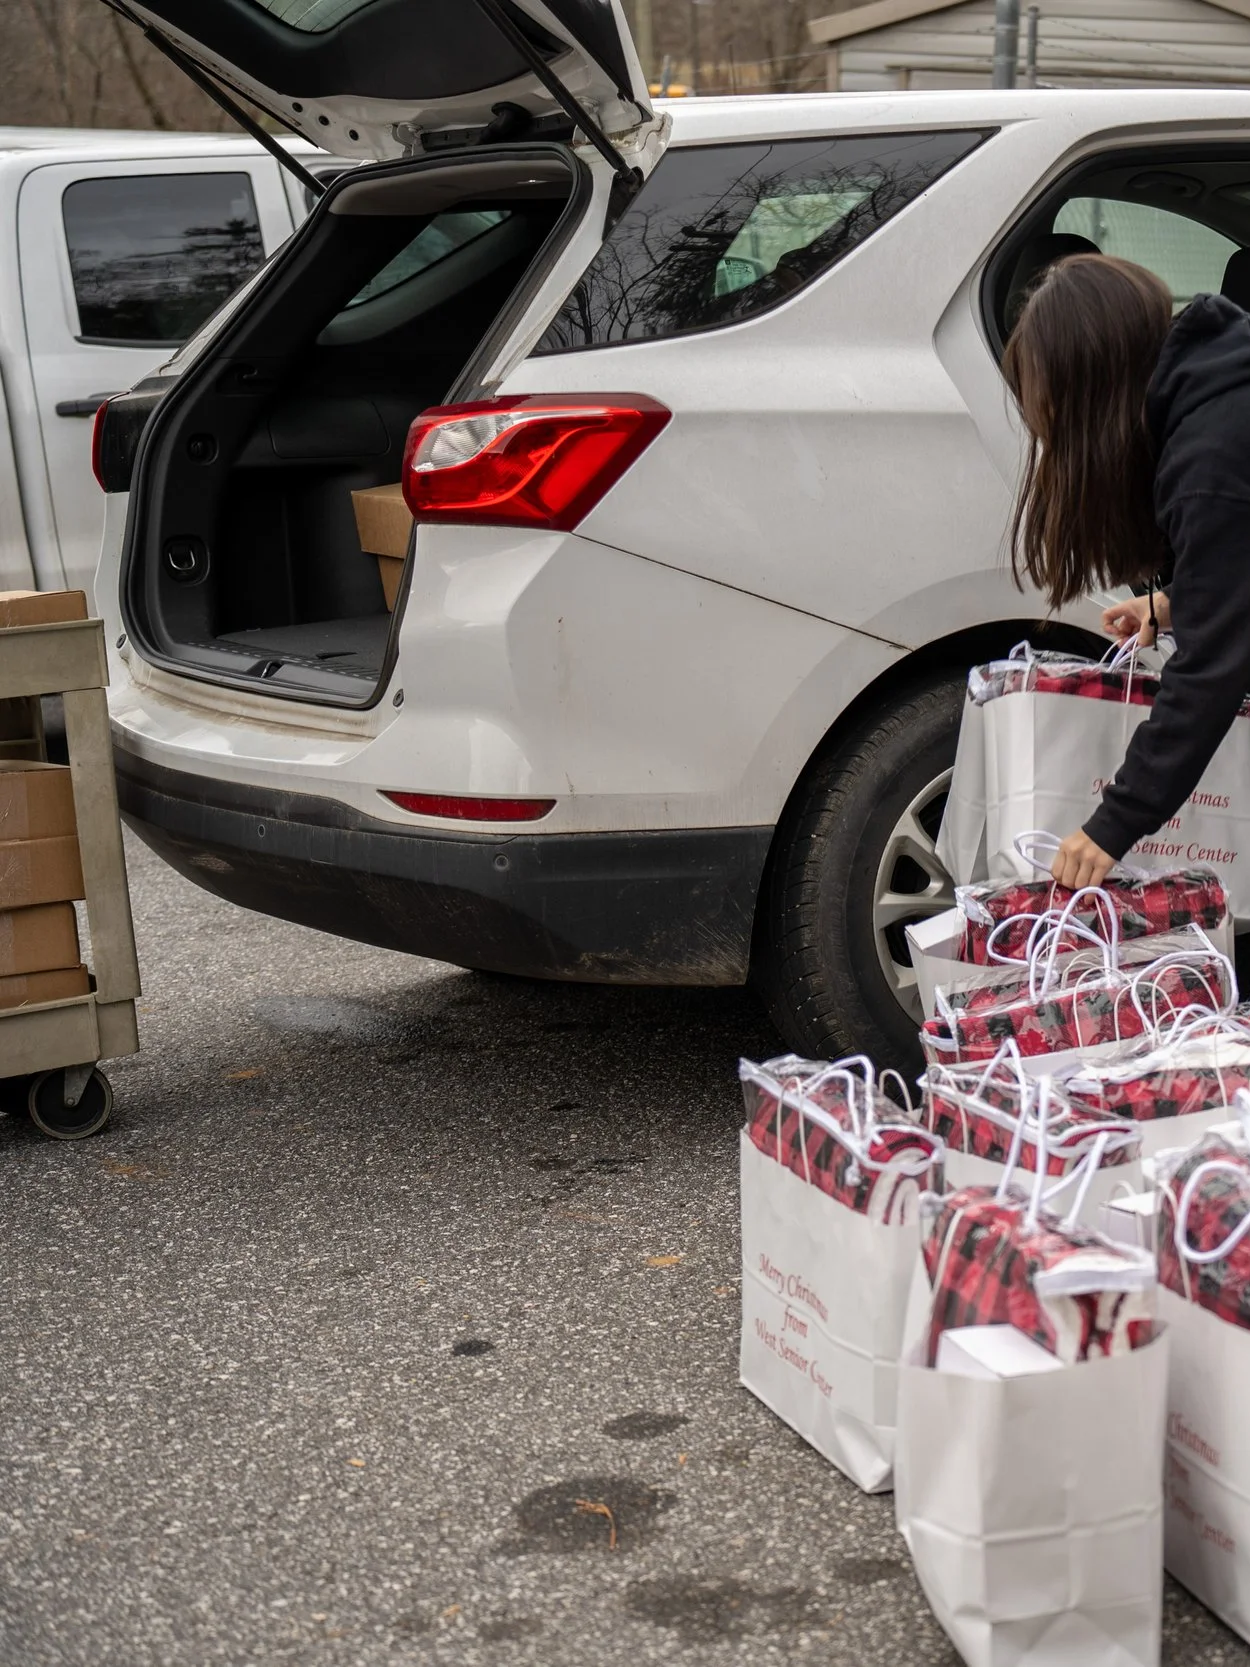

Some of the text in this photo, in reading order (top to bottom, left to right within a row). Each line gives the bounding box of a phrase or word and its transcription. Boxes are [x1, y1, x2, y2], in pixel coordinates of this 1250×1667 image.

[1130, 837, 1238, 864] Senior Center
[759, 1253, 785, 1294] Merry
[781, 1304, 808, 1338] from
